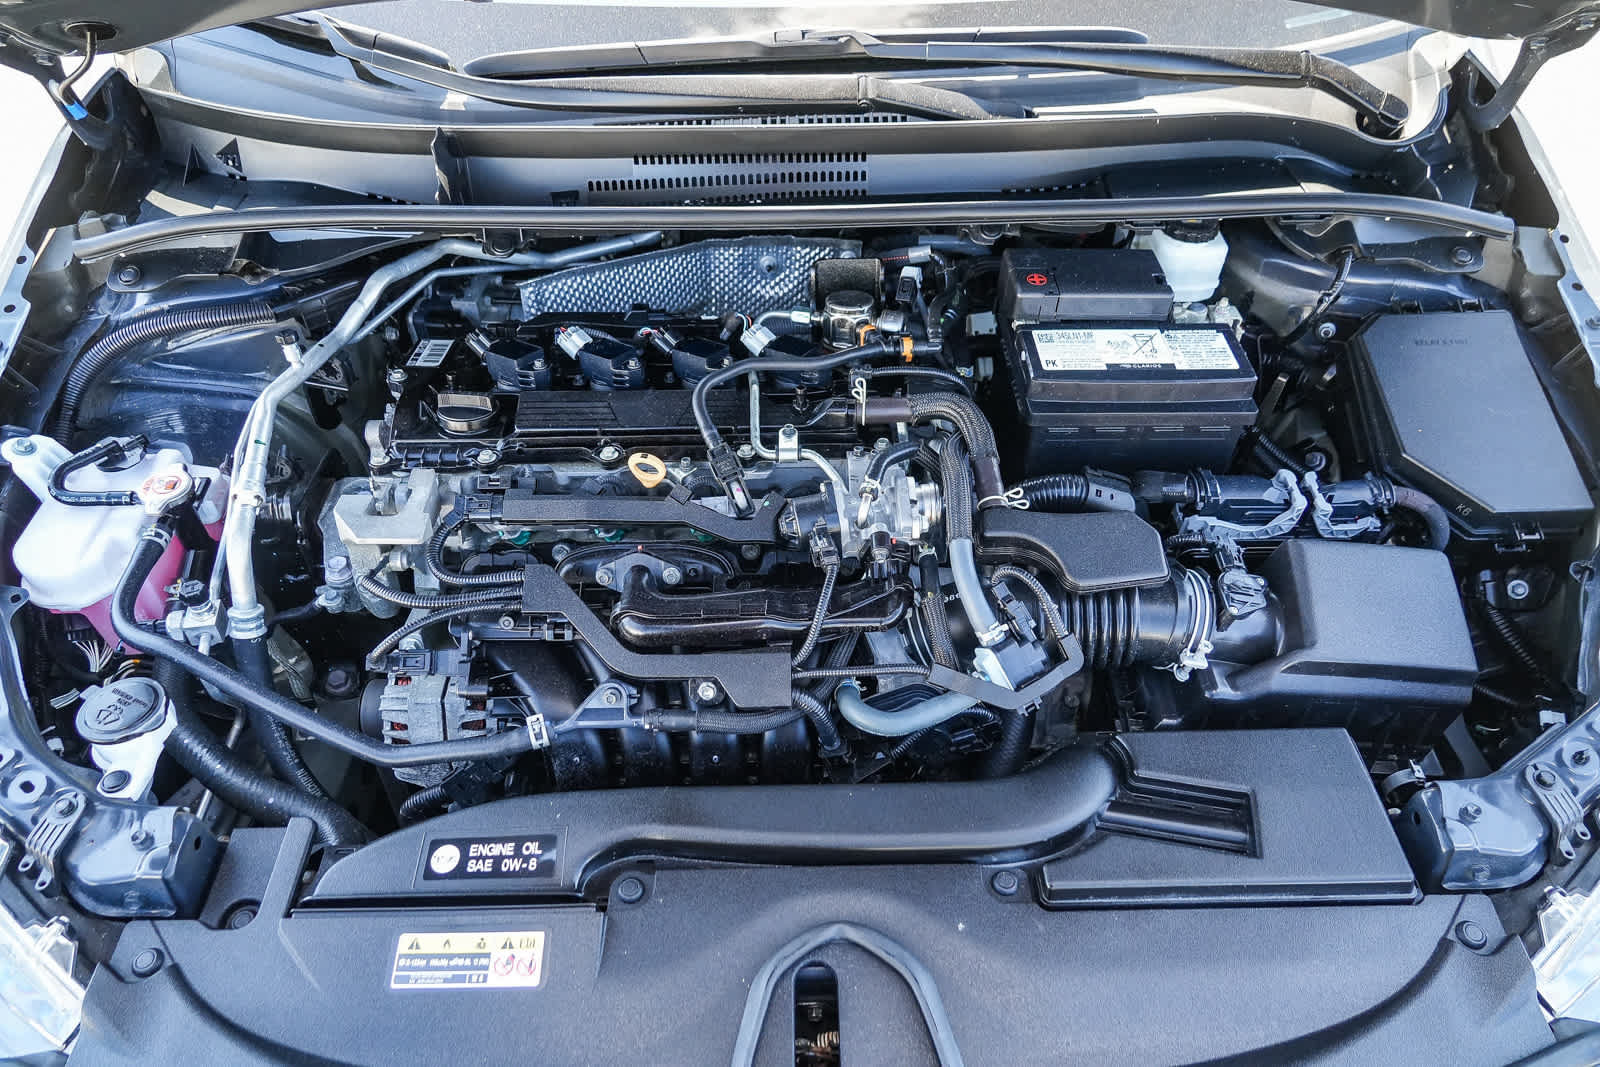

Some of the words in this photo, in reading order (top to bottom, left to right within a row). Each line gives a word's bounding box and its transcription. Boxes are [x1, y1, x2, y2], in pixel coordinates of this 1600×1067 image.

[1045, 359, 1058, 368] PK
[468, 842, 516, 857] ENGINE
[522, 841, 543, 856] OIL
[466, 858, 494, 873] SAE
[501, 857, 537, 872] 0W-8
